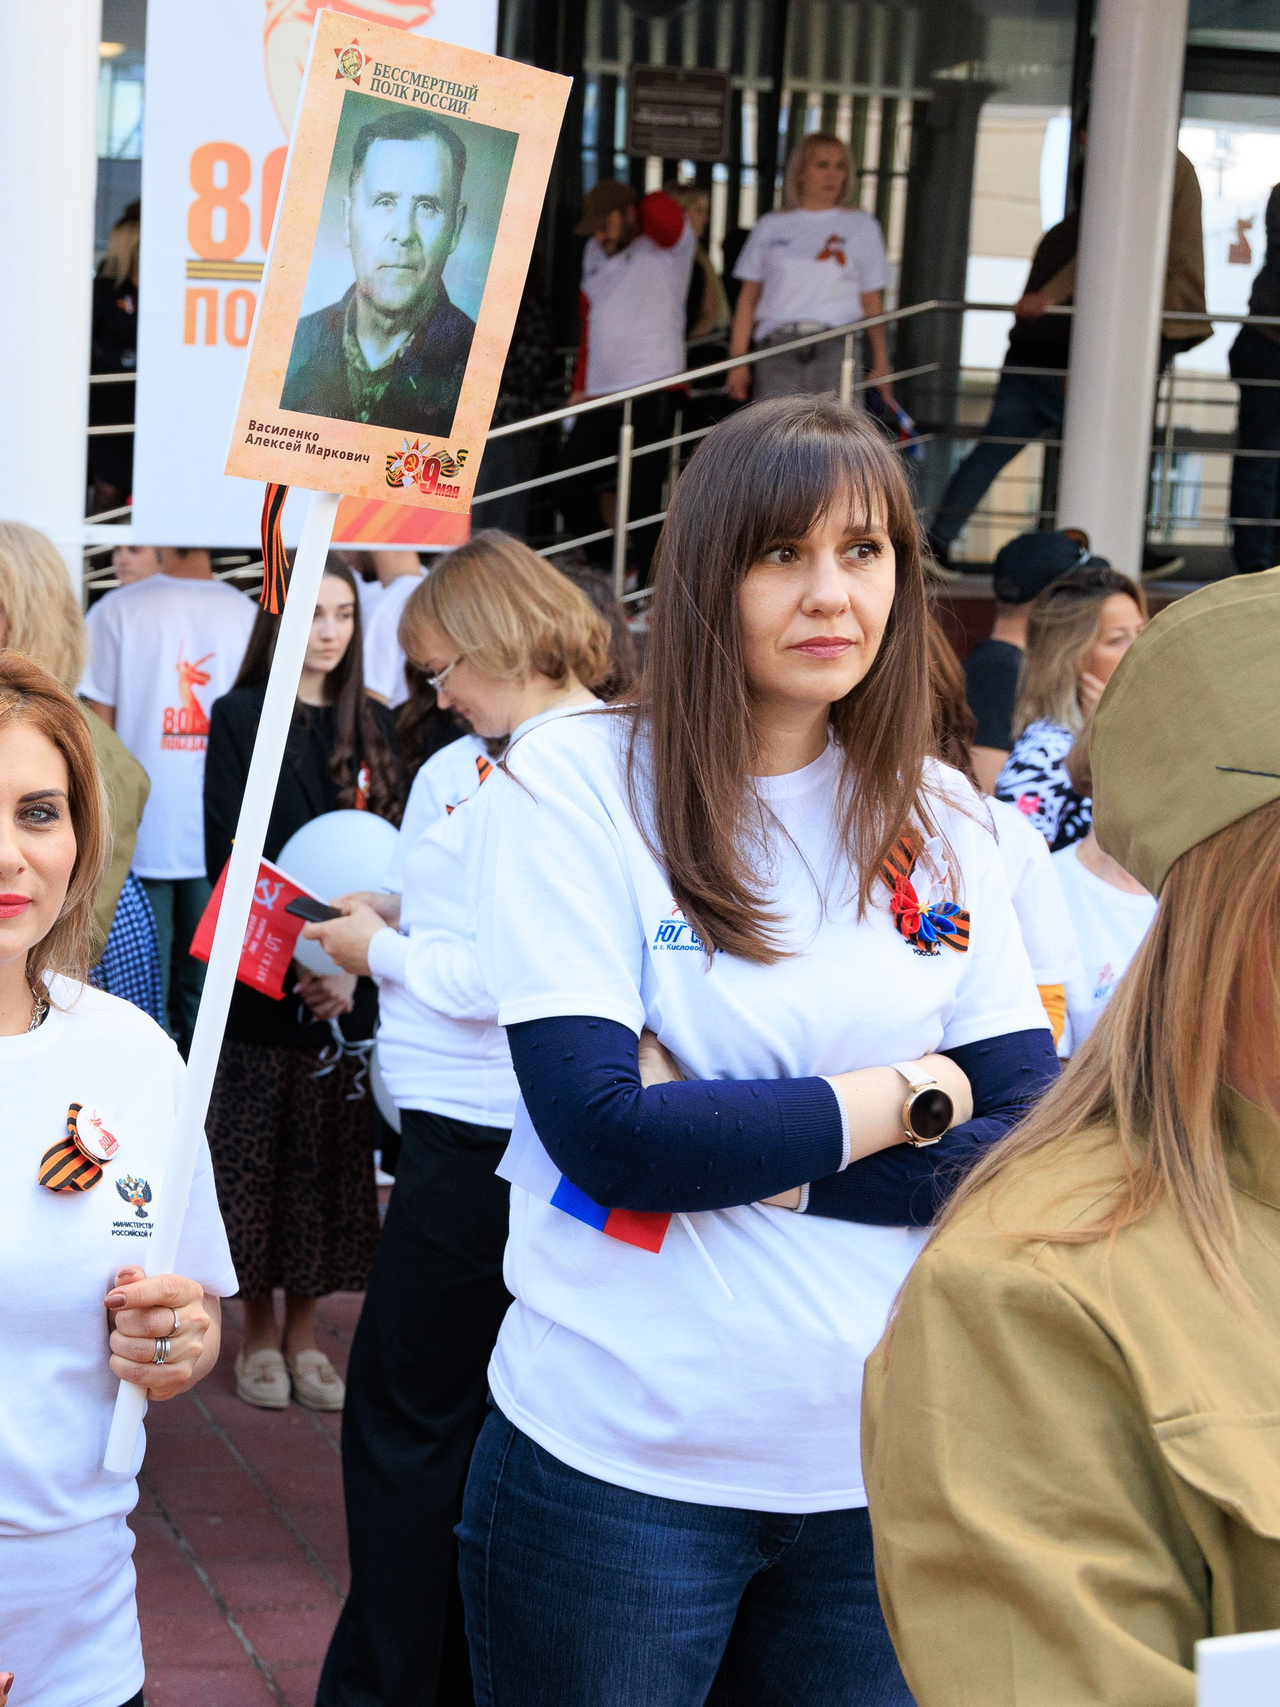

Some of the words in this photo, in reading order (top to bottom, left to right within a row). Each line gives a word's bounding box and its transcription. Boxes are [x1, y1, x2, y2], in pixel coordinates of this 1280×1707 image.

[373, 62, 479, 102] БЕССМЕРТНЫЙ
[369, 77, 411, 100] ПОЛК
[411, 91, 469, 115] РОССИИ
[183, 287, 257, 347] ПО
[248, 419, 320, 442] Василенко
[244, 433, 302, 453] Алексей
[306, 443, 371, 464] Маркович
[420, 457, 442, 495] 9
[163, 707, 188, 734] 80
[654, 925, 687, 943] ЮГ
[666, 943, 703, 952] Кислово
[98, 1135, 113, 1150] 80
[111, 1229, 148, 1237] РОССИЙСКОЙ
